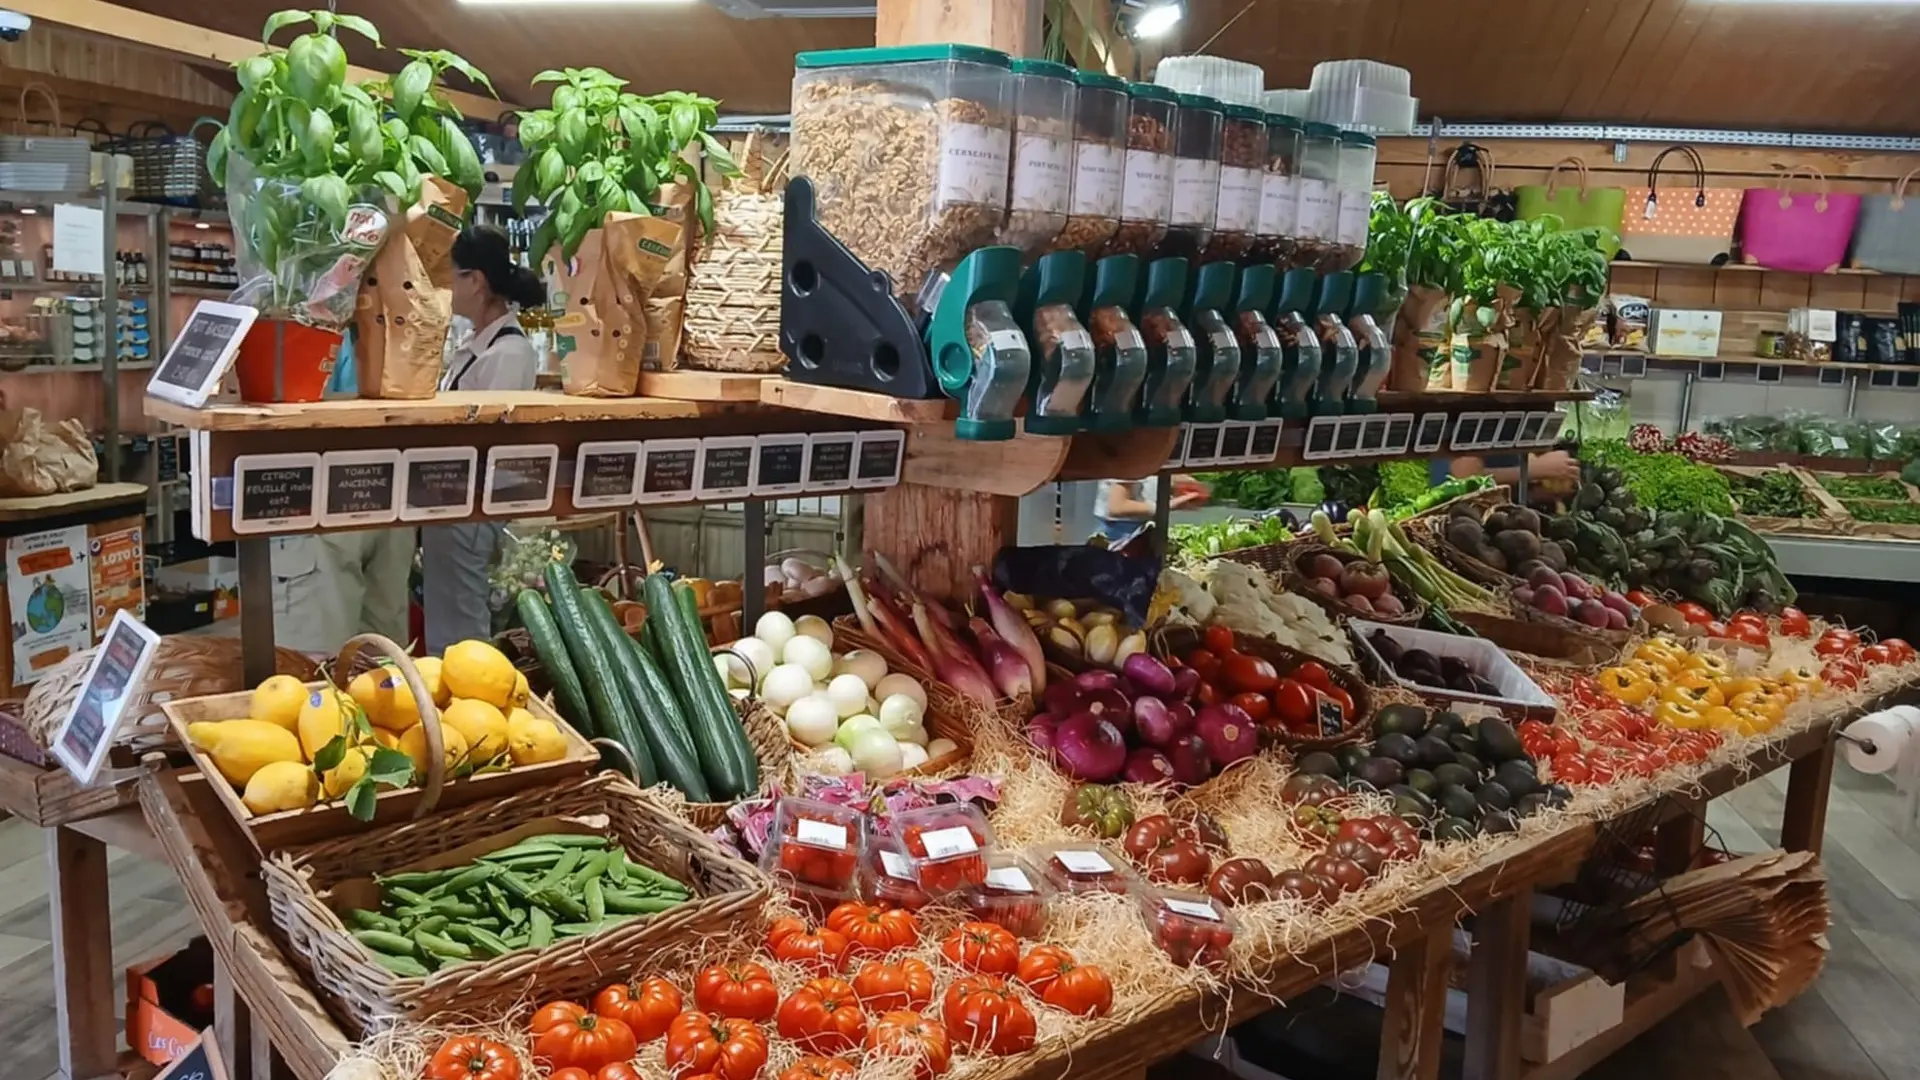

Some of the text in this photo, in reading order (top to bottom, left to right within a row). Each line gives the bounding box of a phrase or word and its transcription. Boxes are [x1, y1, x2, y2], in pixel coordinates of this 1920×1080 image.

[260, 471, 301, 482] CITRON
[344, 466, 383, 477] TOMATE
[337, 477, 388, 488] ANCIENNE
[102, 549, 131, 566] LOTO
